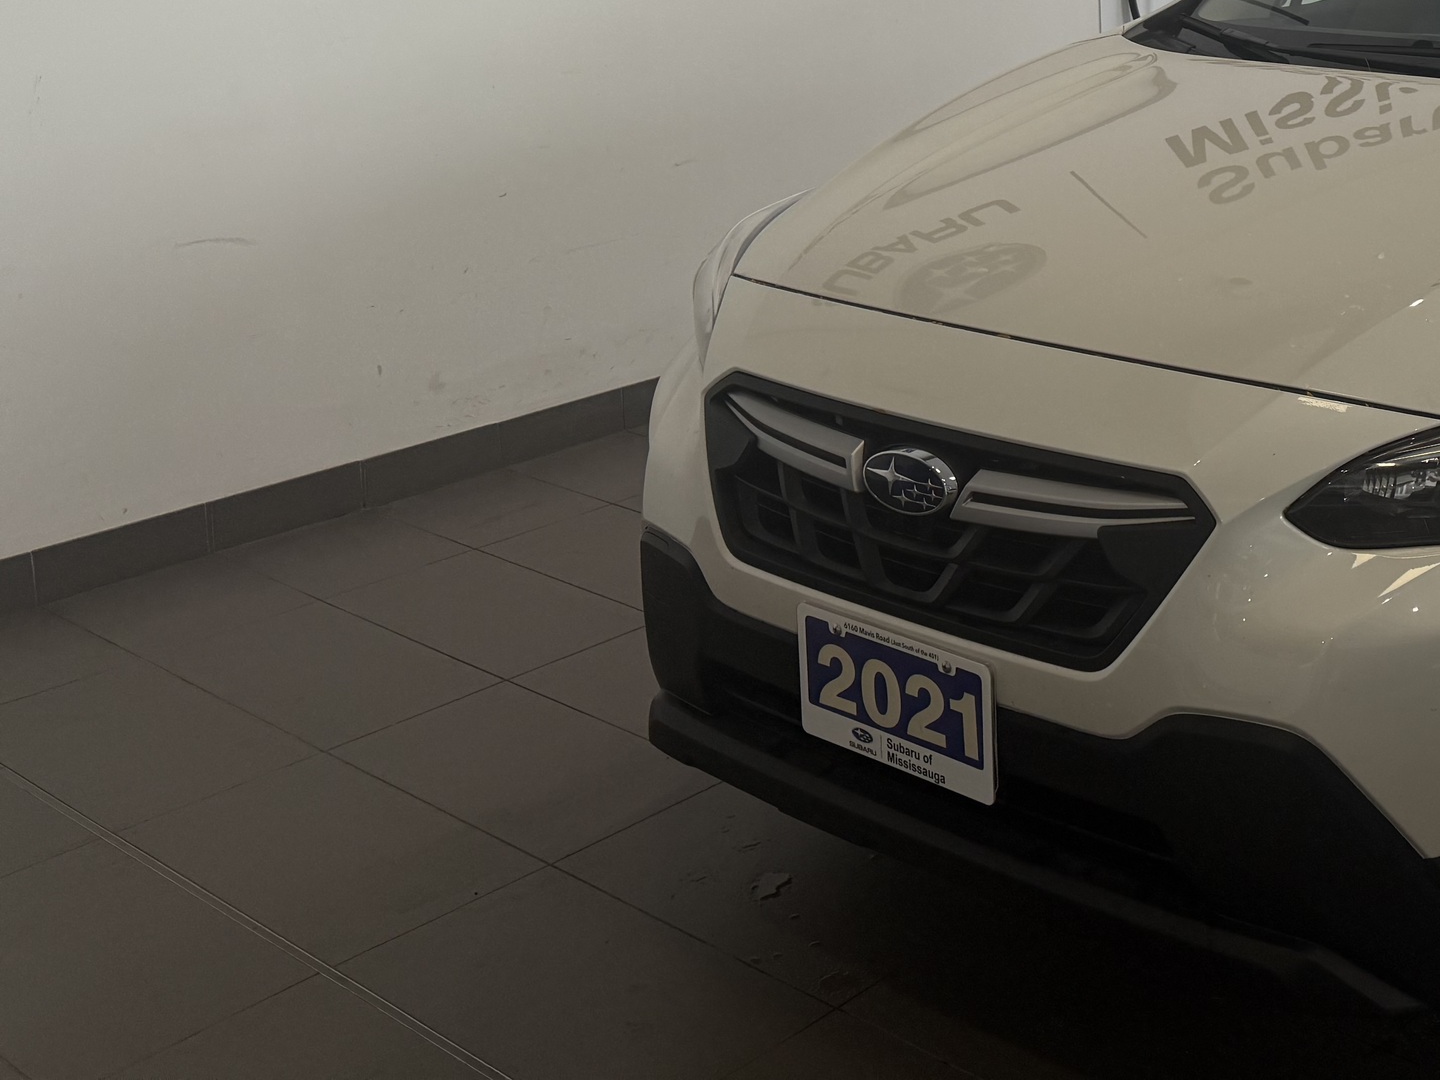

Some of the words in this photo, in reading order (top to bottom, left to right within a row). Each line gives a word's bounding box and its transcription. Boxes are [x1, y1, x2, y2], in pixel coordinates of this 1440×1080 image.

[843, 622, 859, 632] 6160
[859, 626, 875, 638] Mavis
[876, 633, 890, 644] Road
[817, 643, 980, 761] 2021
[849, 740, 877, 756] SUBARU
[886, 738, 921, 760] Subaru
[923, 754, 933, 765] of
[887, 751, 946, 784] Mississauga
